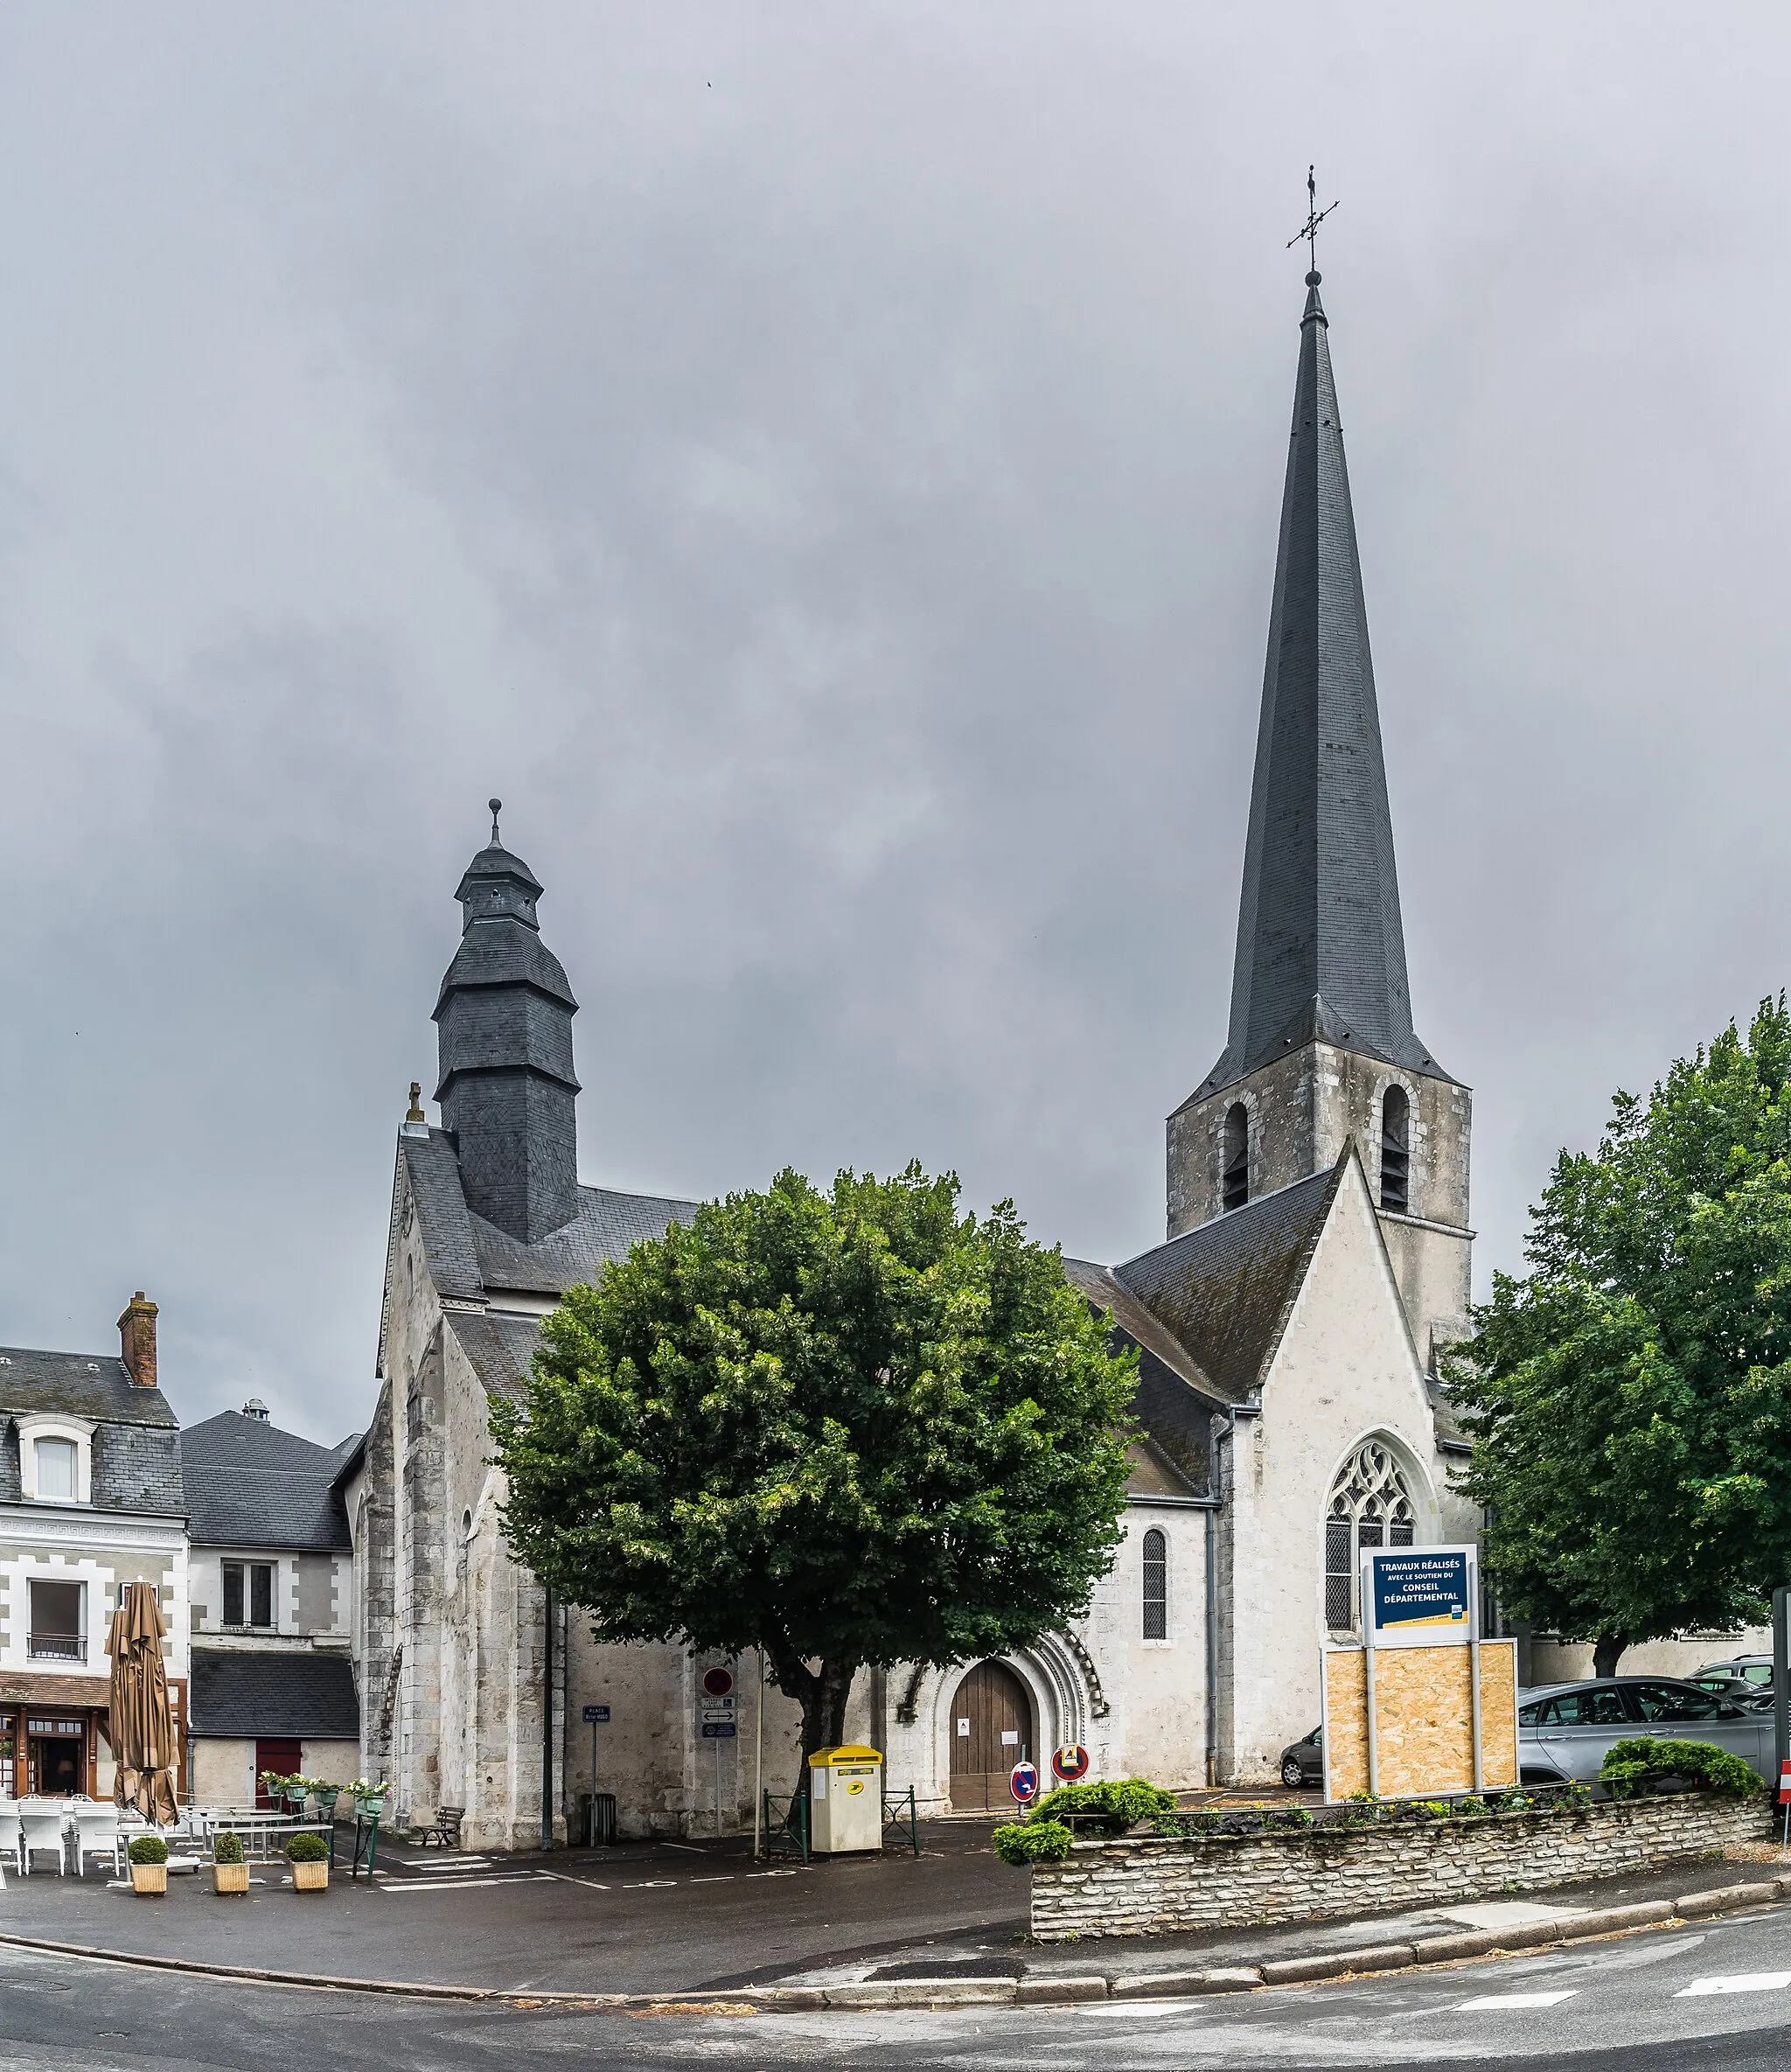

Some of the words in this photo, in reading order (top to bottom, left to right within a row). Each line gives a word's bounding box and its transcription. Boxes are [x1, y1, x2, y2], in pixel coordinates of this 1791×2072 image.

[1380, 1562, 1420, 1572] TRAVAUX
[1421, 1559, 1460, 1570] RÉALISÉS
[1402, 1582, 1439, 1592] CONSEIL
[1383, 1592, 1459, 1604] DÉPARTEMENTAL
